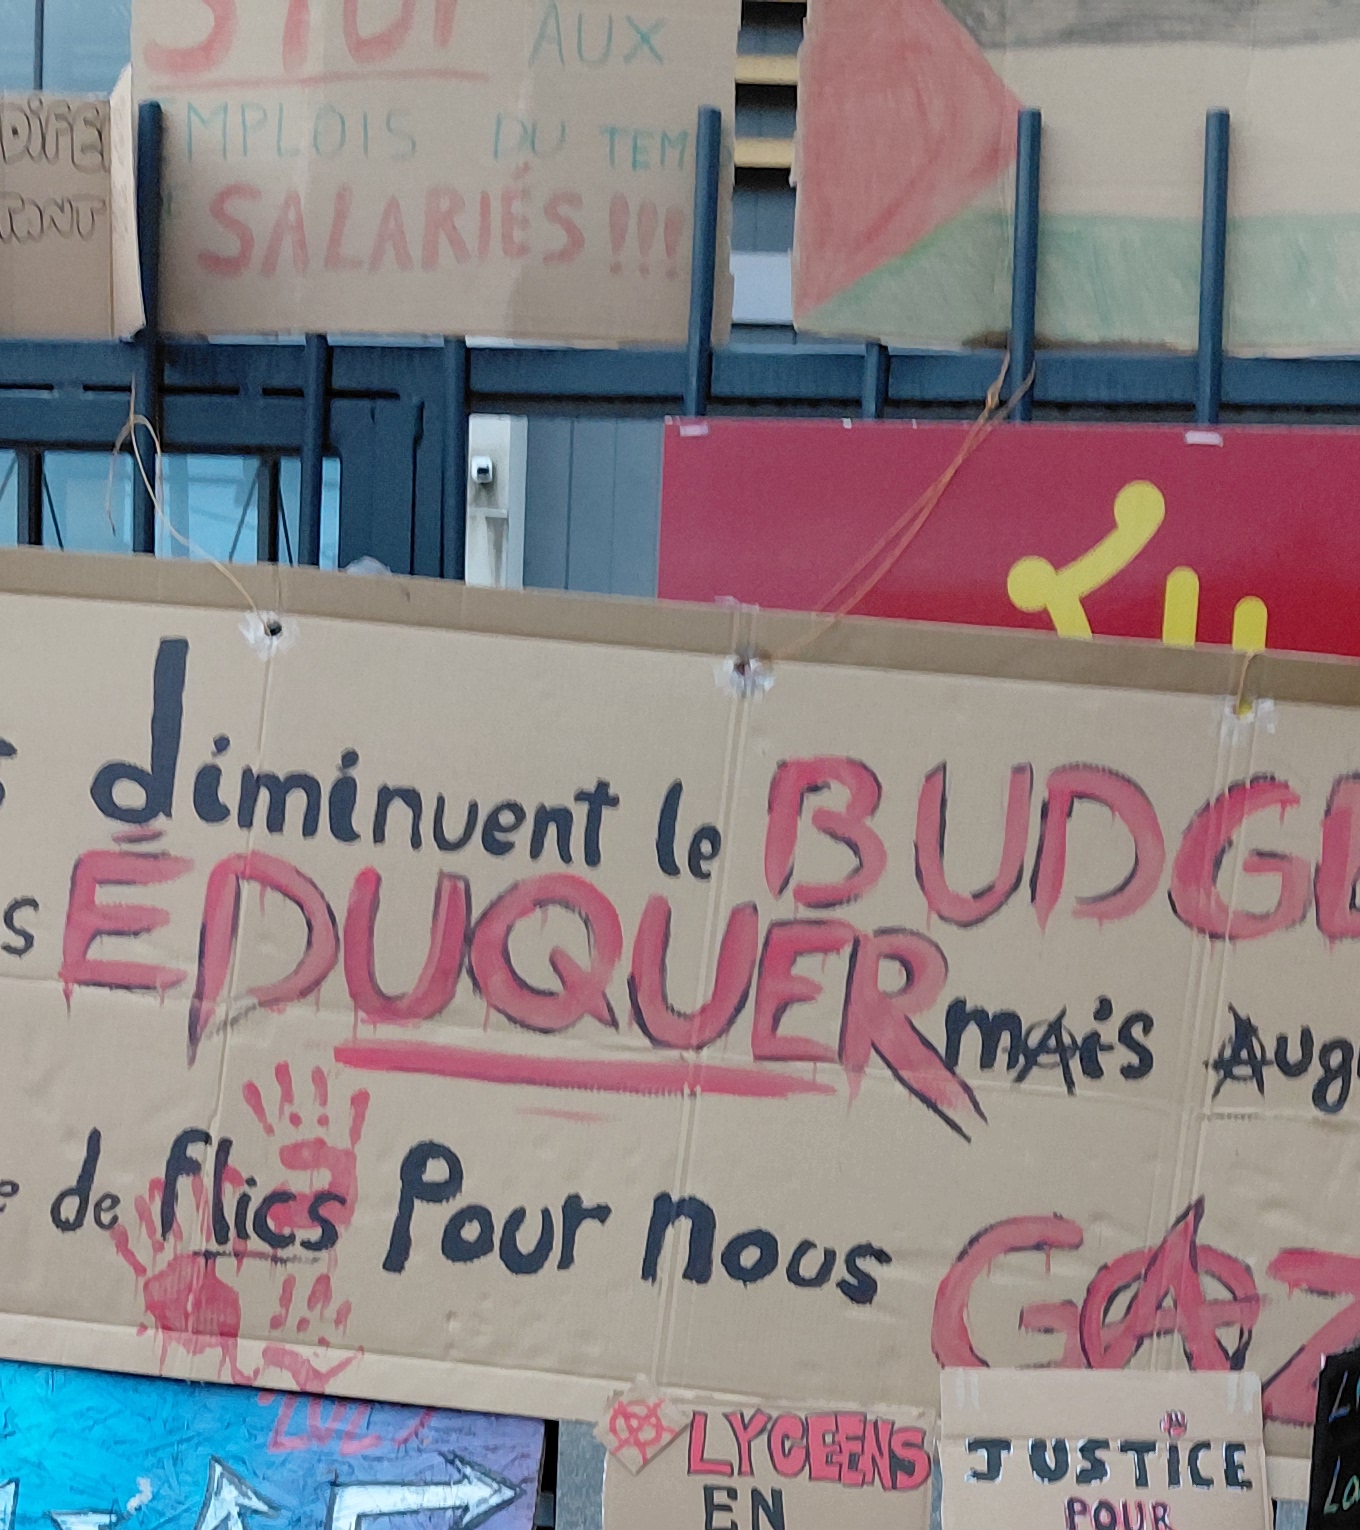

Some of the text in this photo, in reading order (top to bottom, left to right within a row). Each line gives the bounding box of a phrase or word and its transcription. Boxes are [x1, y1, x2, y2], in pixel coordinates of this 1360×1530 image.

[527, 5, 667, 68] AUX
[138, 97, 730, 172] MPLOIS DU TEM
[197, 162, 586, 280] SALARIÉS
[89, 637, 620, 867] diminuent
[656, 778, 722, 880] le
[58, 826, 988, 1140] ÉDUQUER
[50, 1127, 121, 1233] de
[160, 1126, 347, 1252] flics
[965, 1436, 1253, 1491] JUSTICE
